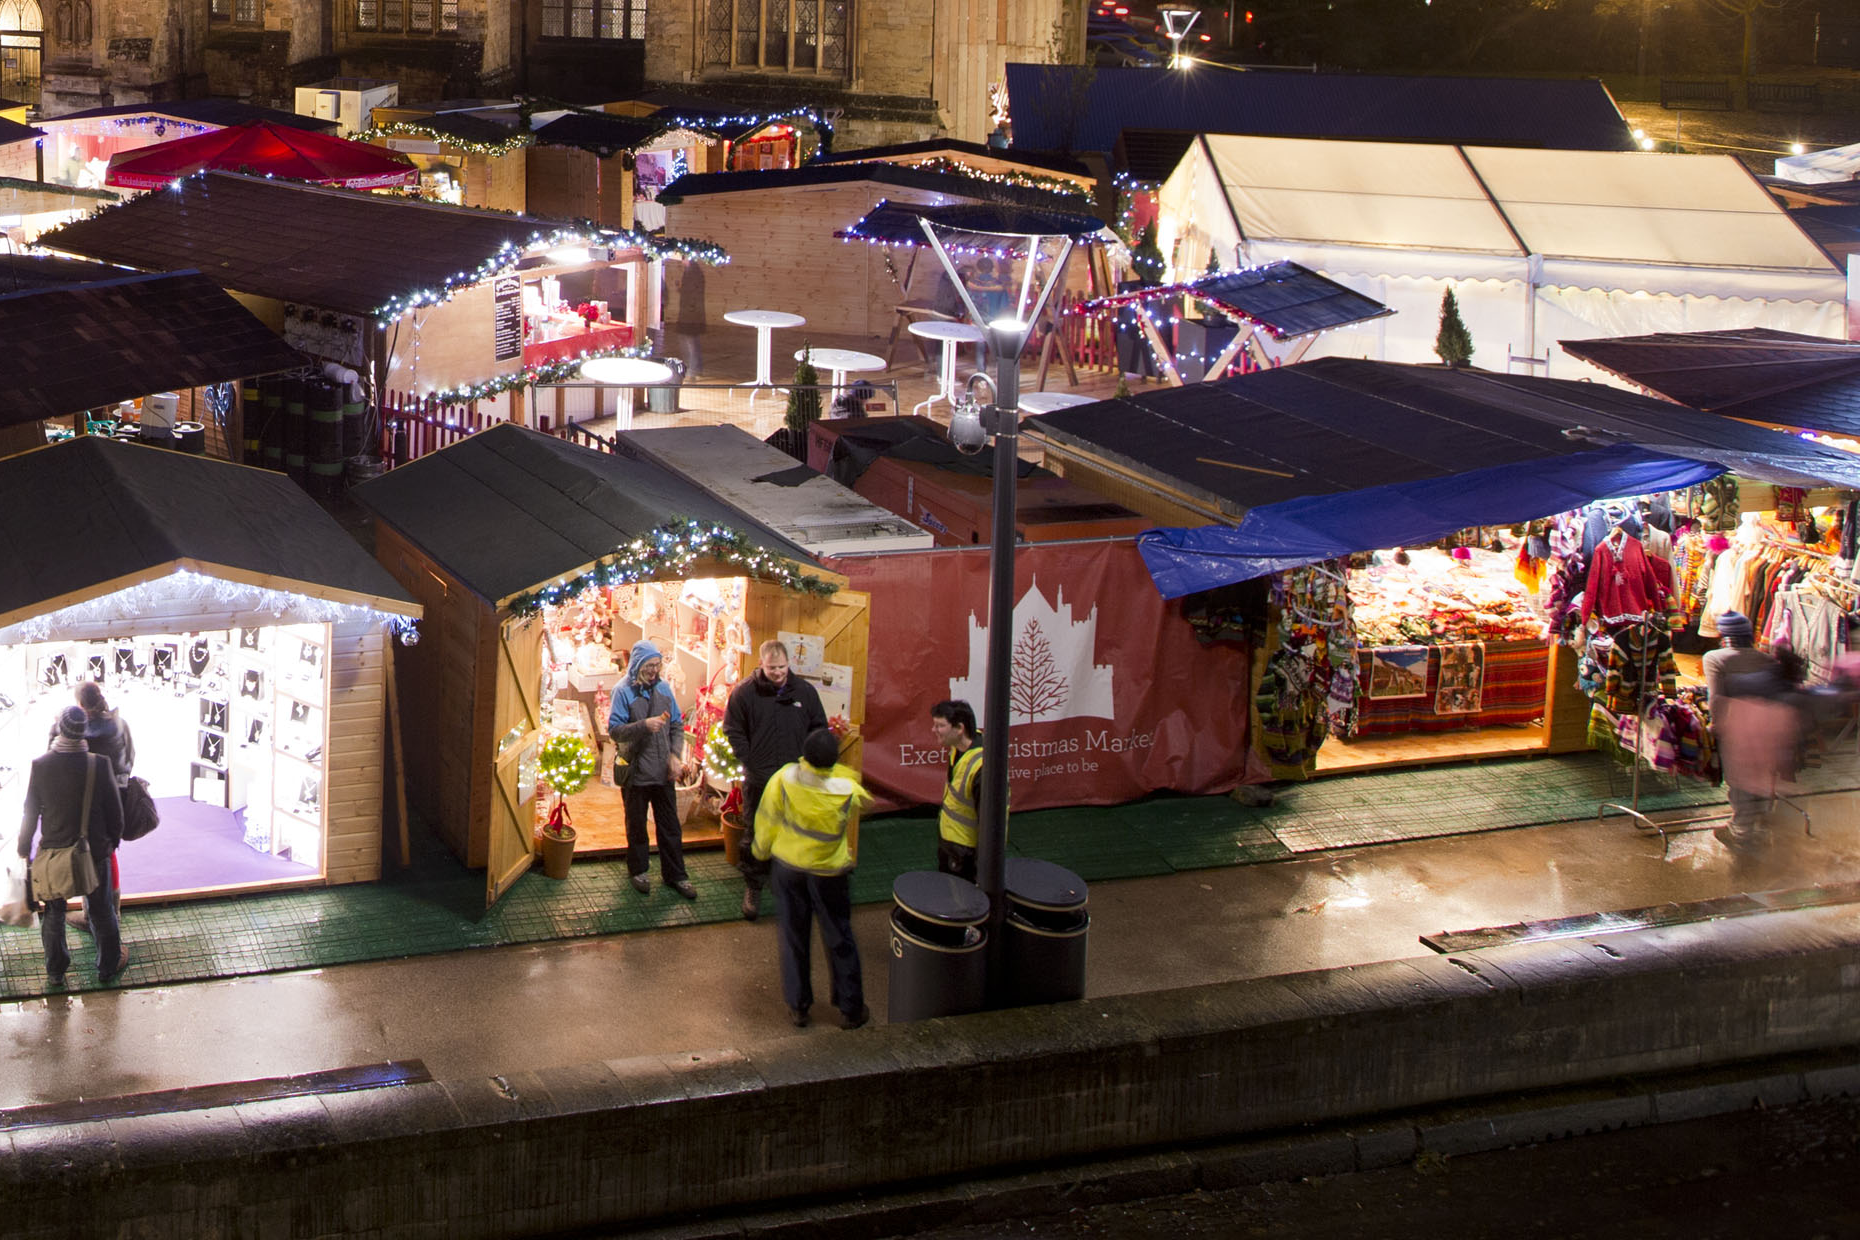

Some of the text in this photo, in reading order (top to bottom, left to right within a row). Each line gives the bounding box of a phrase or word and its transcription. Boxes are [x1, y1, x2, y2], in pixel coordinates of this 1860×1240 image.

[1085, 729, 1156, 752] Market
[1034, 762, 1064, 781] place
[1067, 763, 1080, 773] to
[1081, 757, 1099, 772] be
